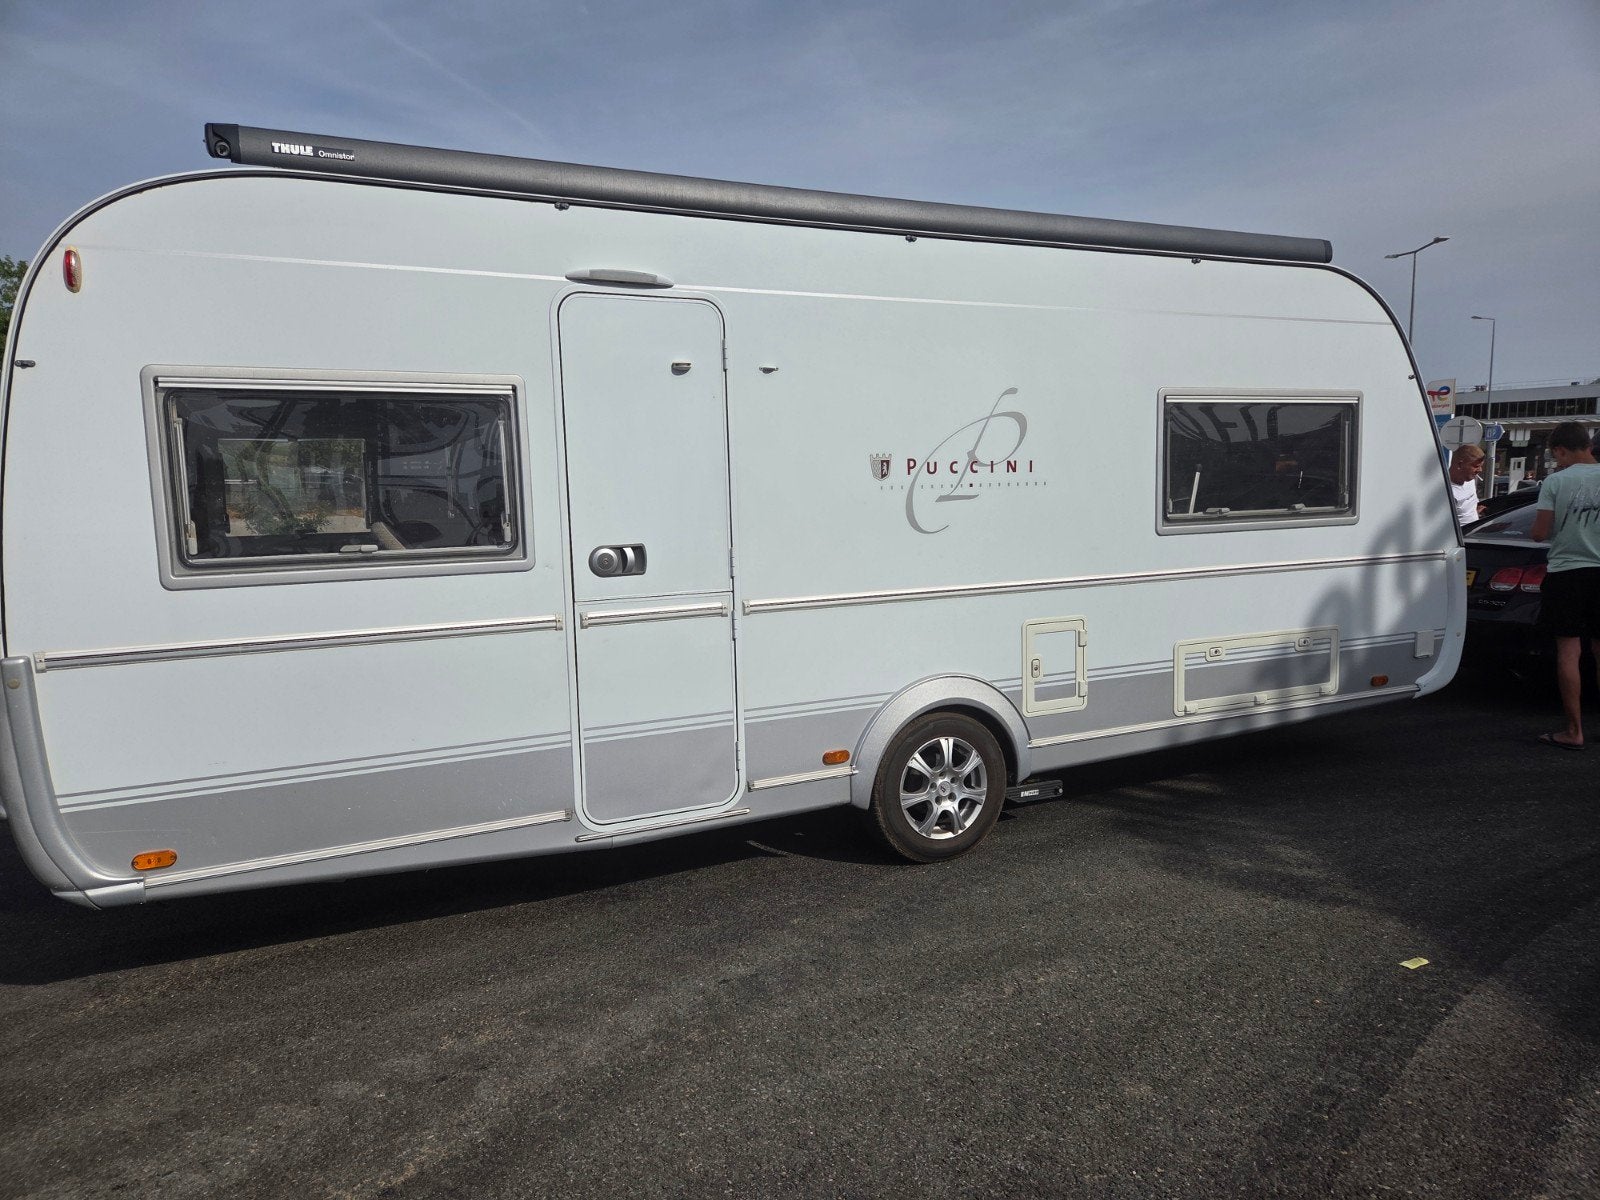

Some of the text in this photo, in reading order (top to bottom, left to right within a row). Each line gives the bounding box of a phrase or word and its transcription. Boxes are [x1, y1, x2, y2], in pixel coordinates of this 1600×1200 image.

[271, 142, 355, 161] THULE Omnistor
[906, 457, 1034, 476] PUCCINI
